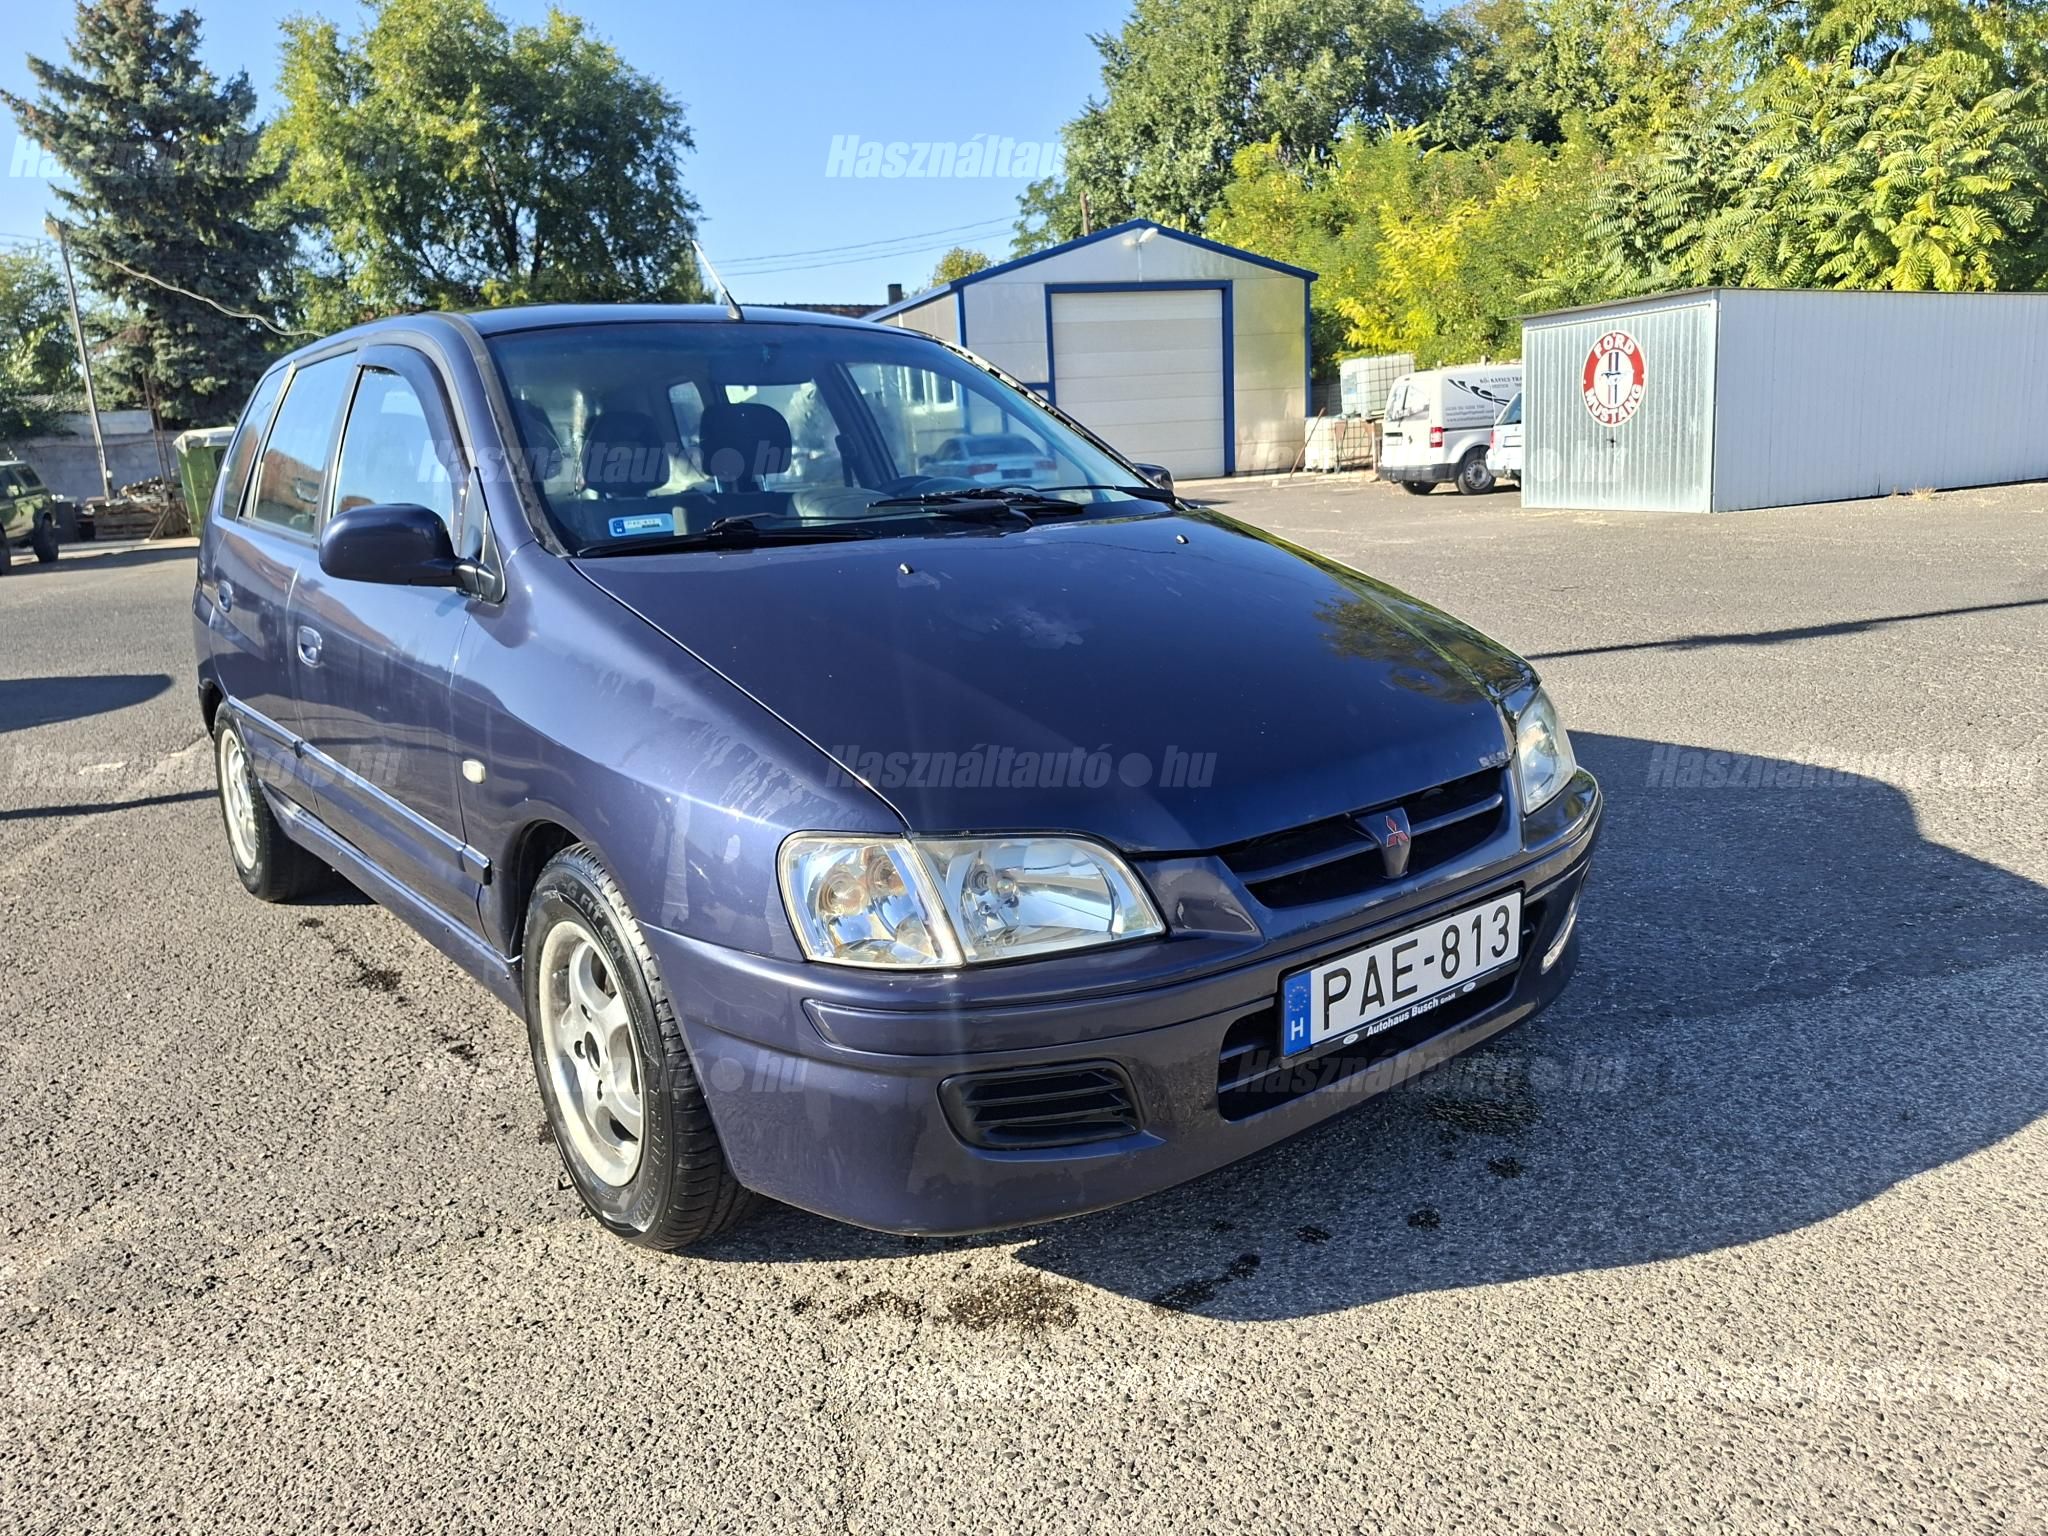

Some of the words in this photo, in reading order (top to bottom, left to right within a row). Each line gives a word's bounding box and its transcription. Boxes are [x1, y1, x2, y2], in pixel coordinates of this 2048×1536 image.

[1593, 334, 1636, 359] FORD
[1584, 383, 1643, 423] MUSTANG
[1322, 904, 1510, 1031] PAE-813
[1290, 1017, 1304, 1041] H
[1366, 1011, 1410, 1037] Autohaus
[1411, 997, 1439, 1017] Busch
